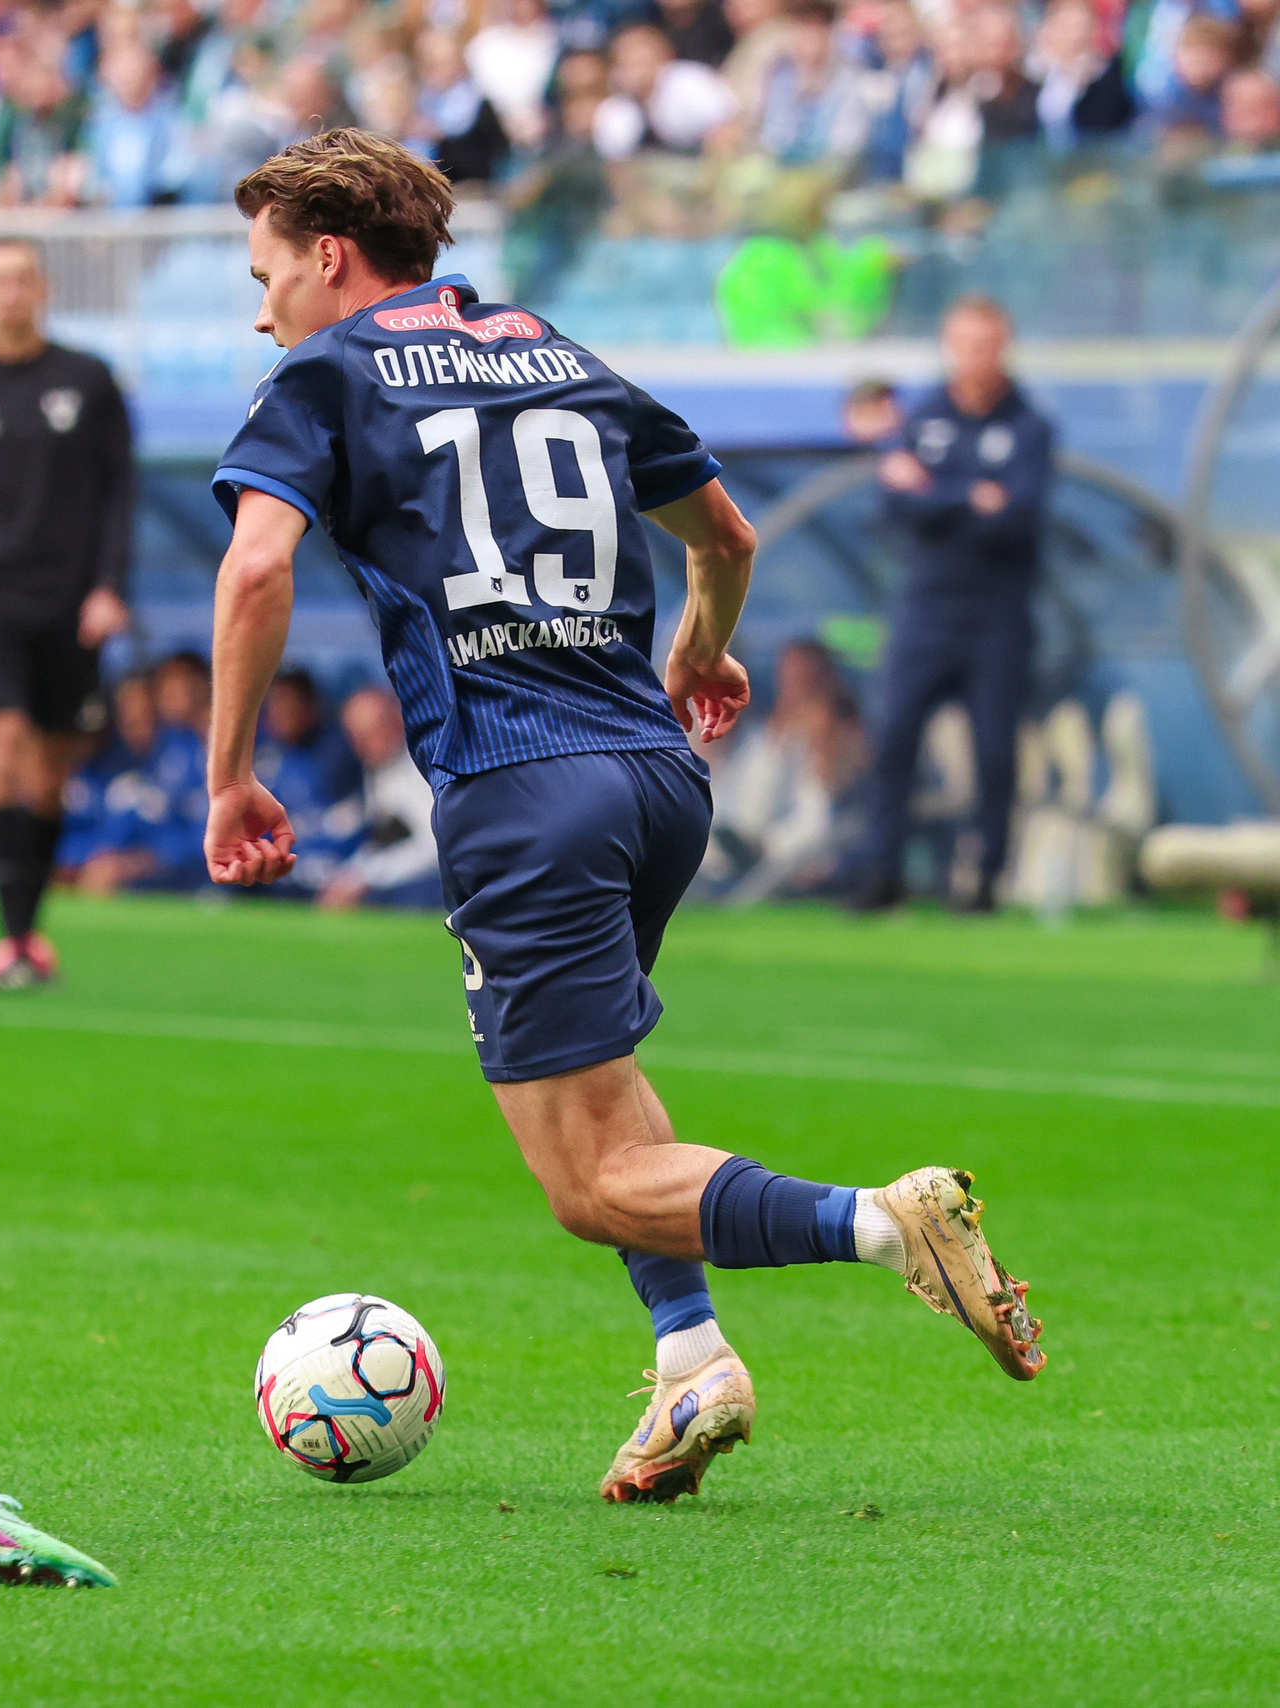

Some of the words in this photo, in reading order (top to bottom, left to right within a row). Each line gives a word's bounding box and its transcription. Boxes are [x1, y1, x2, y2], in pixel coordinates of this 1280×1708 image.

[388, 313, 534, 341] СОЛИДНОСТЬ
[484, 313, 522, 327] БАНК
[373, 338, 589, 388] ОЛЕЙНИКОВ
[415, 407, 618, 612] 19
[447, 617, 569, 667] АМАРСКАЯ
